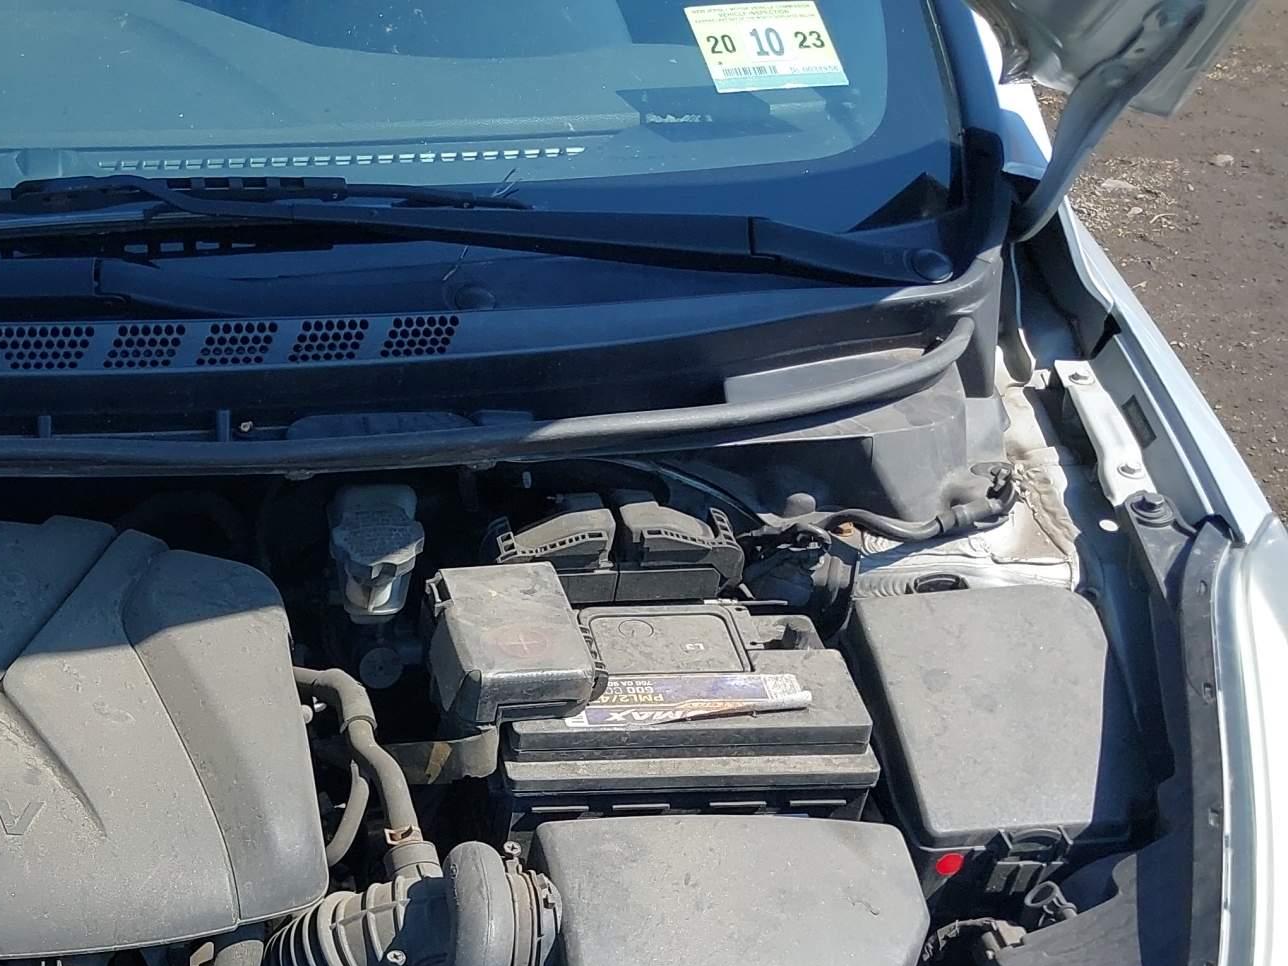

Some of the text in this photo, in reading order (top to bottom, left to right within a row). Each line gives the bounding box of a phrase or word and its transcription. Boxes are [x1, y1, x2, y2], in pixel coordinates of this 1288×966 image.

[706, 27, 825, 56] 20 10 23
[605, 708, 690, 721] MAX
